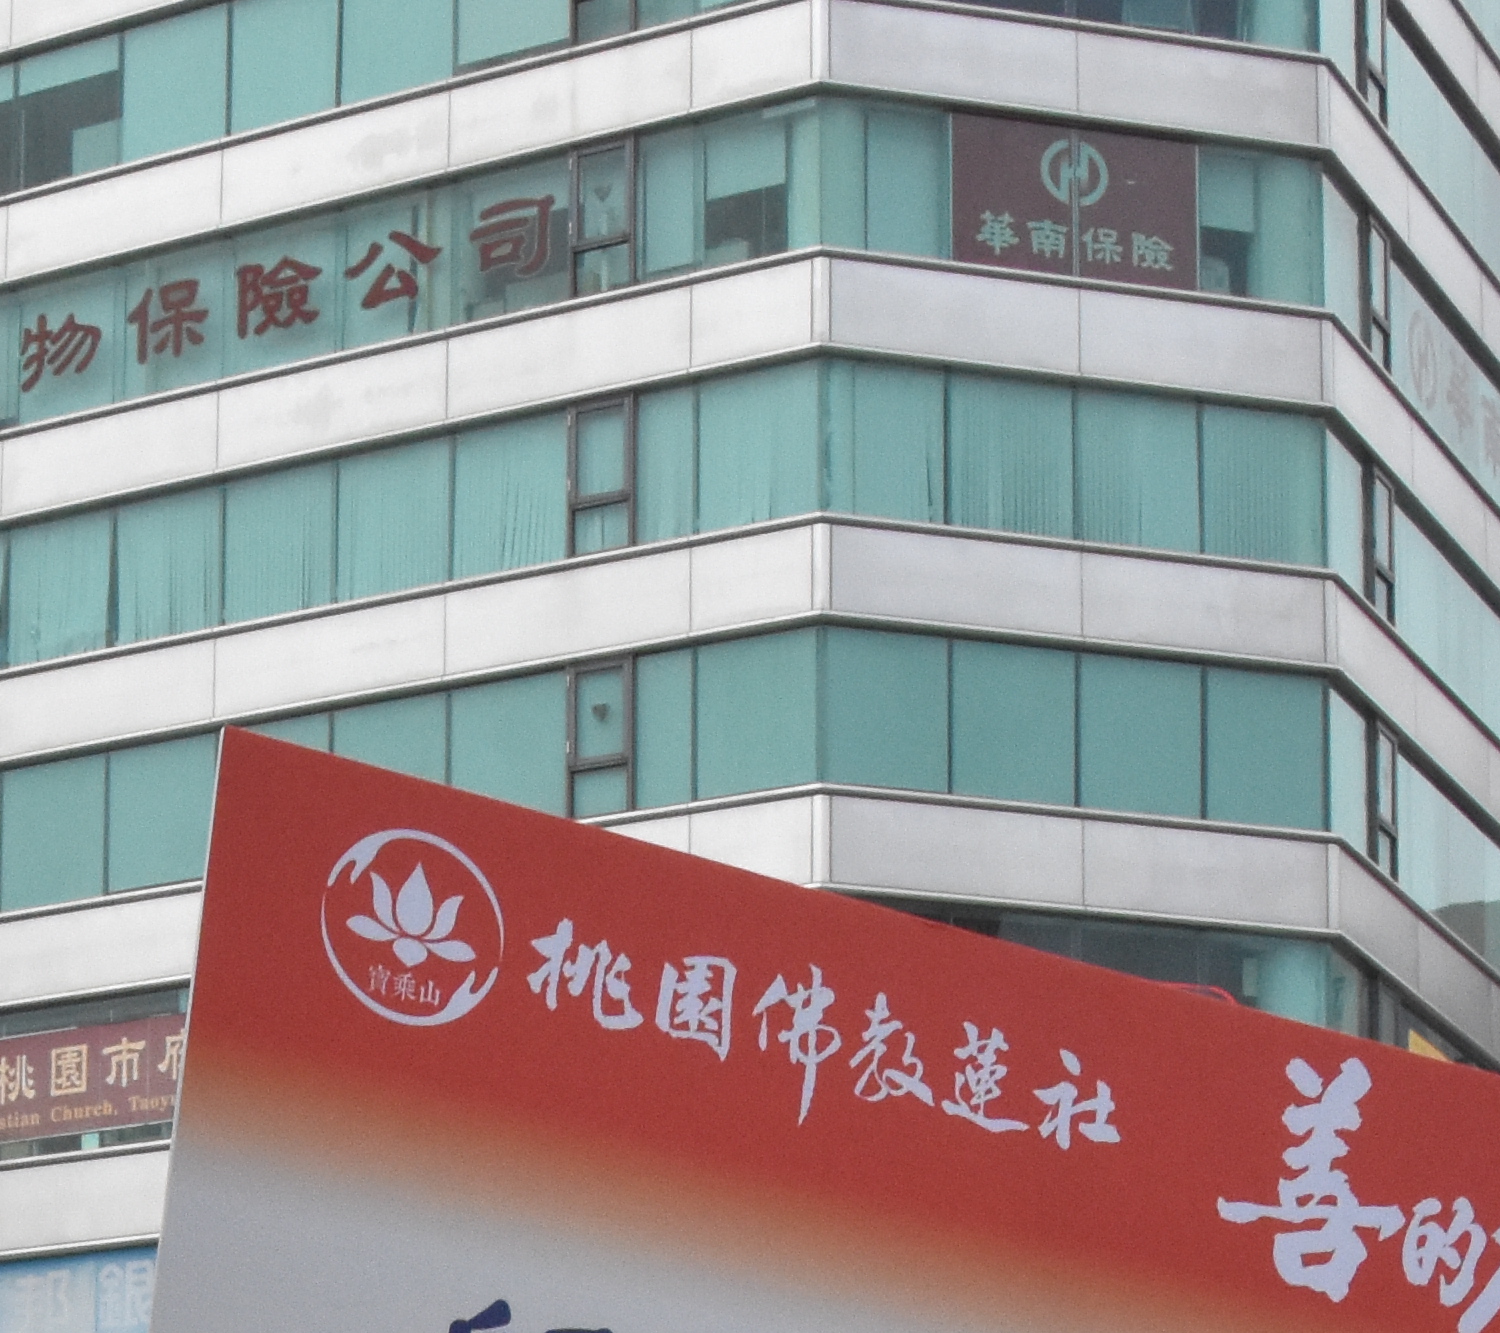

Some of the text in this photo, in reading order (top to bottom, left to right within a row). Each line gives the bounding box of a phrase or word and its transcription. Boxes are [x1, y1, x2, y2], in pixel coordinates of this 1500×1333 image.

[976, 208, 1178, 273] 華南保險
[524, 913, 1124, 1150] 桃園佛教蓮社
